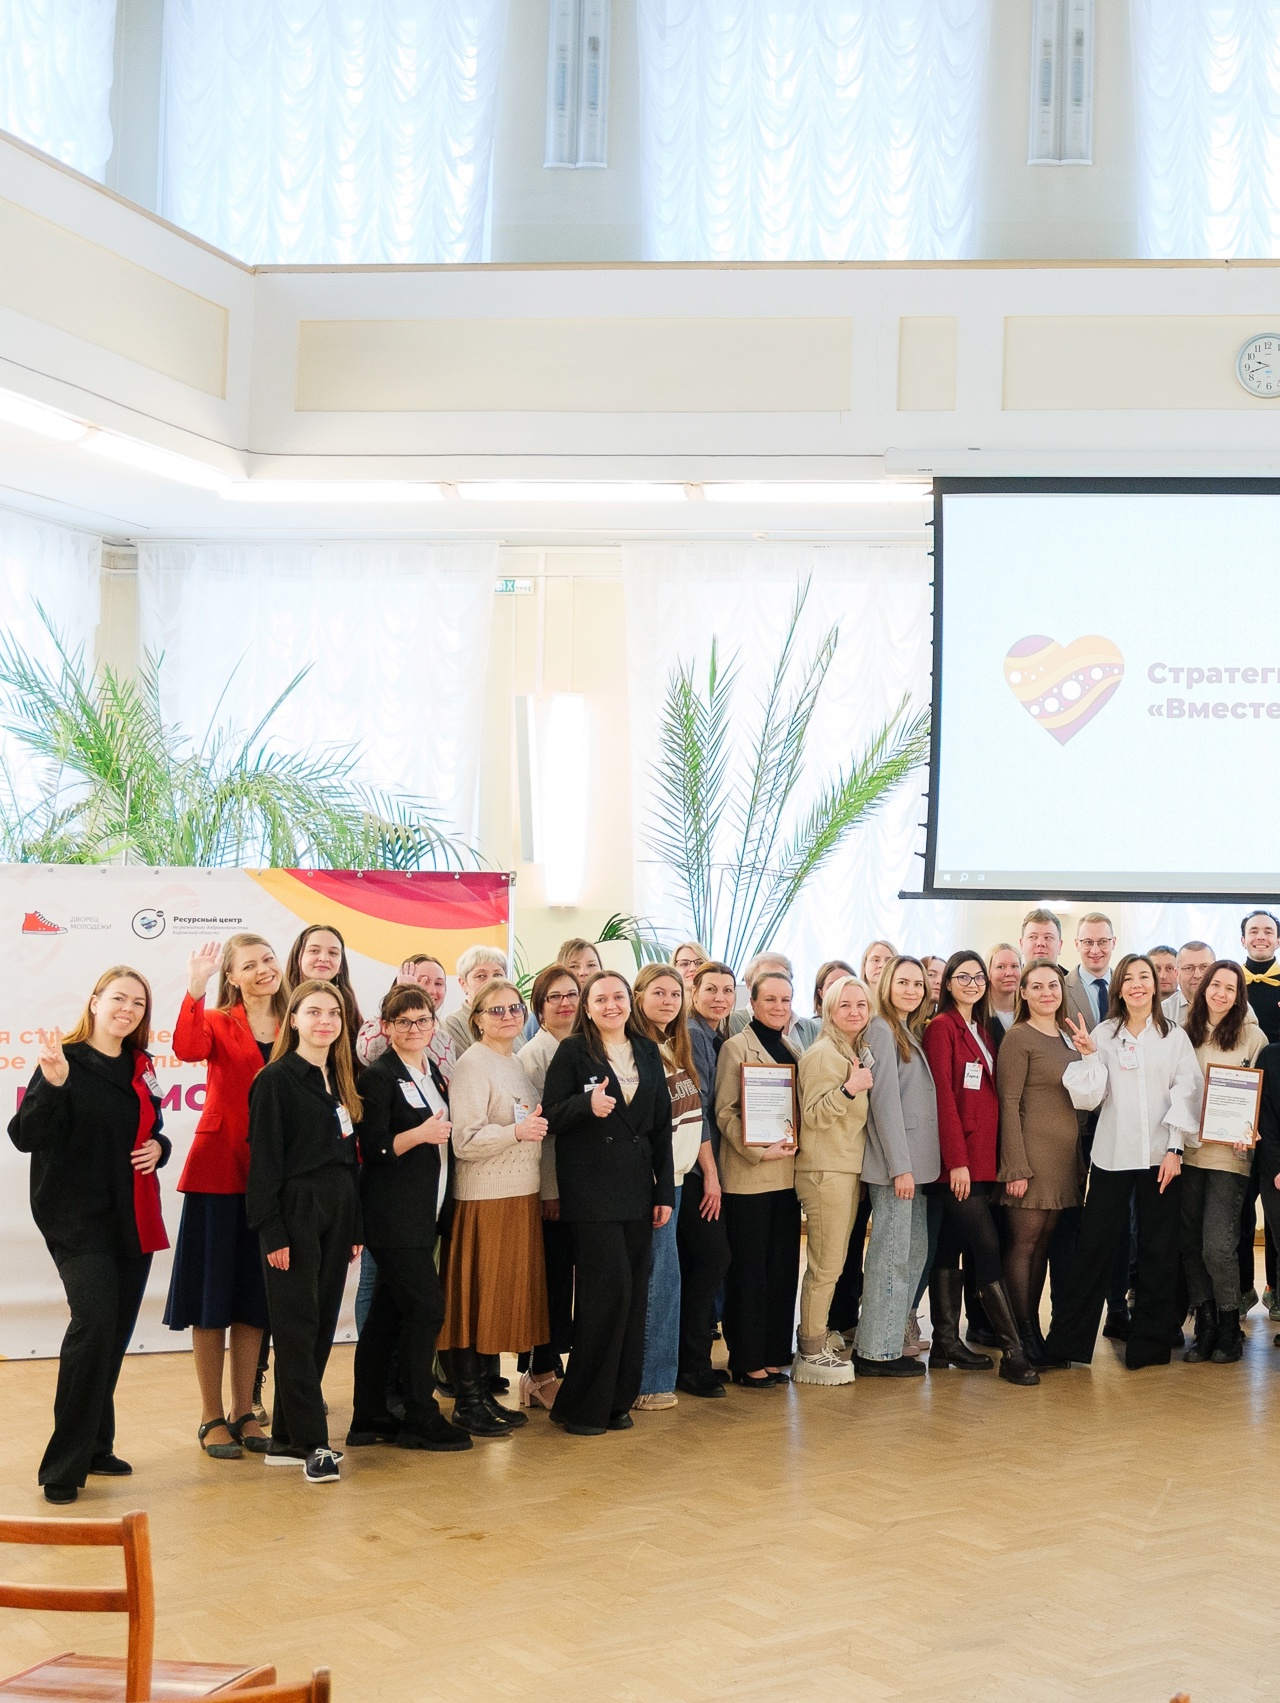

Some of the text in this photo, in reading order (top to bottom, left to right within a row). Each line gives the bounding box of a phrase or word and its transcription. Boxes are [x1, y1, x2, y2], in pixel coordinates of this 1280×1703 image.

[1266, 382, 1272, 390] 6
[70, 916, 99, 924] ДВОРЕЦ
[173, 916, 217, 924] Ресурсный
